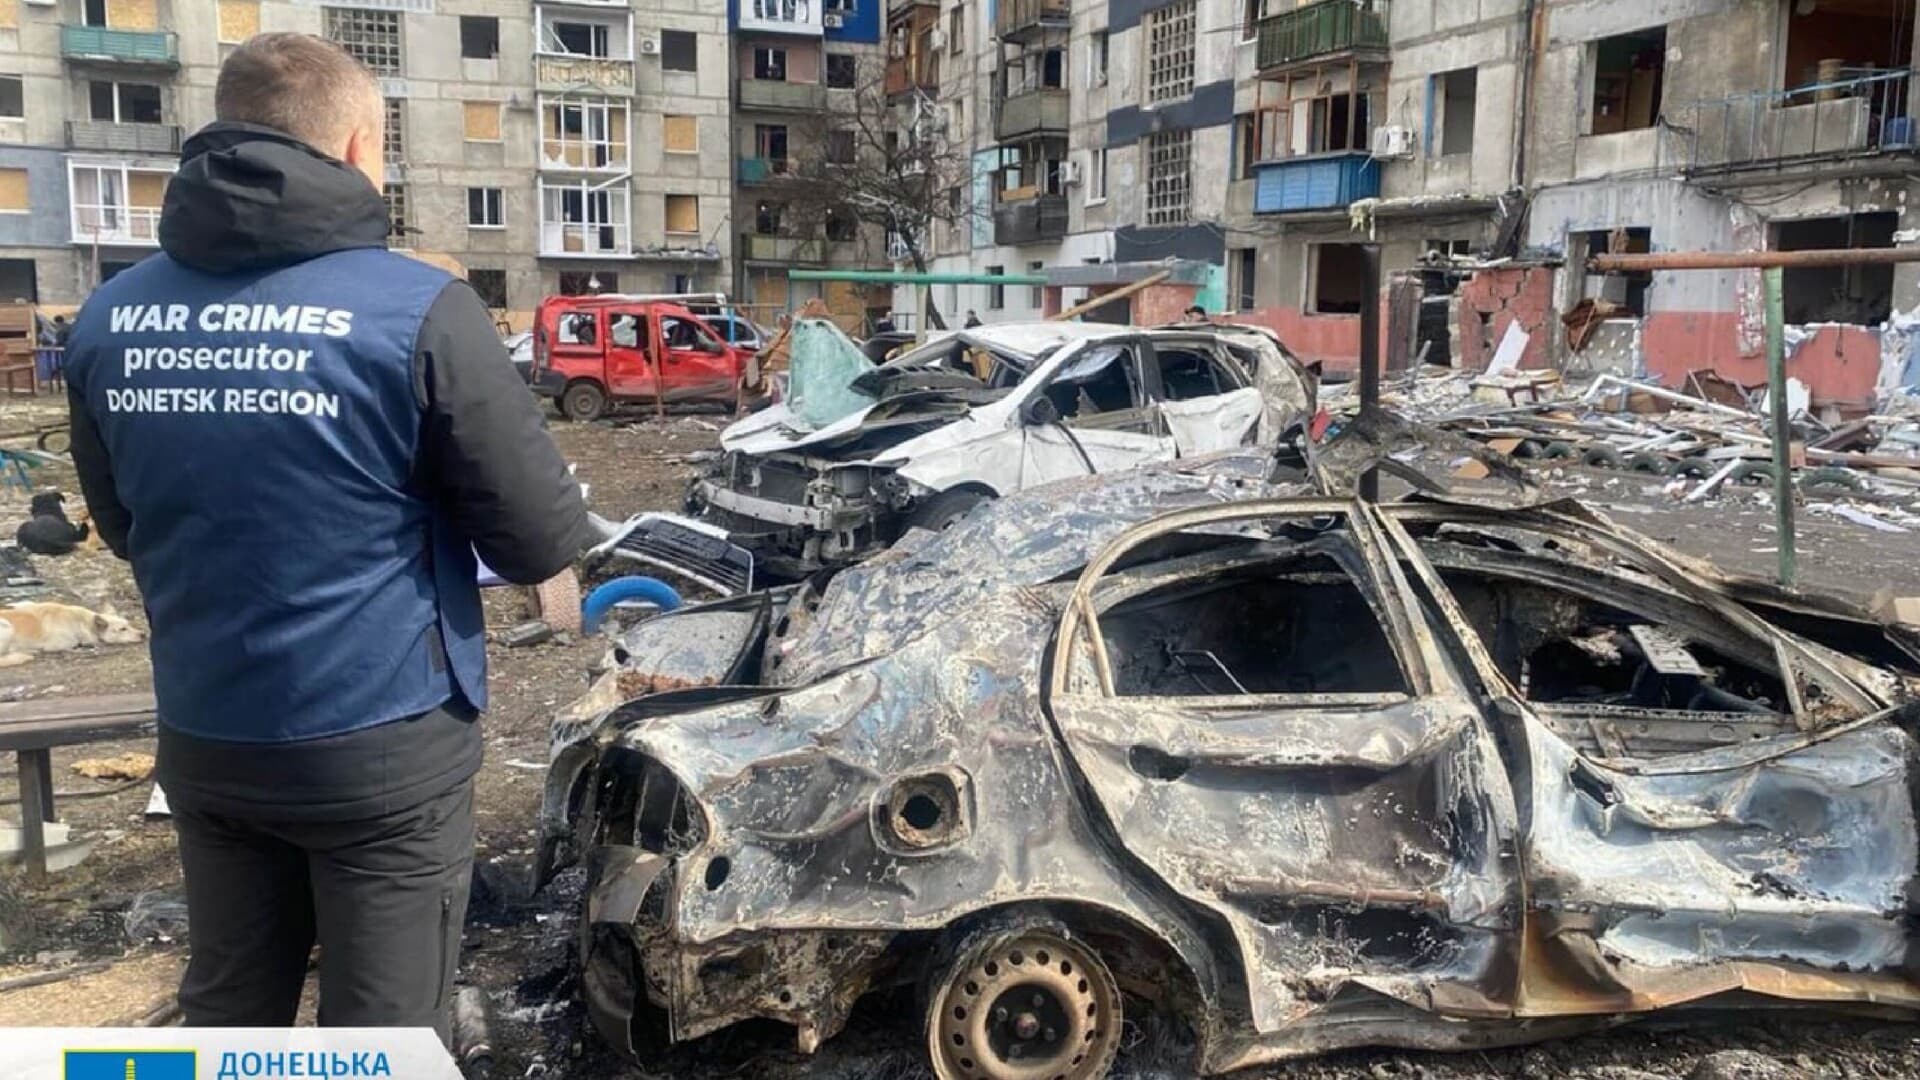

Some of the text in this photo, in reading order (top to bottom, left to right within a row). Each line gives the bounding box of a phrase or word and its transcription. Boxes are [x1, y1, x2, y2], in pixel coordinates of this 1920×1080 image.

[110, 304, 353, 337] WAR CRIMES
[124, 343, 313, 377] prosecutor
[106, 387, 338, 418] DONETSK REGION
